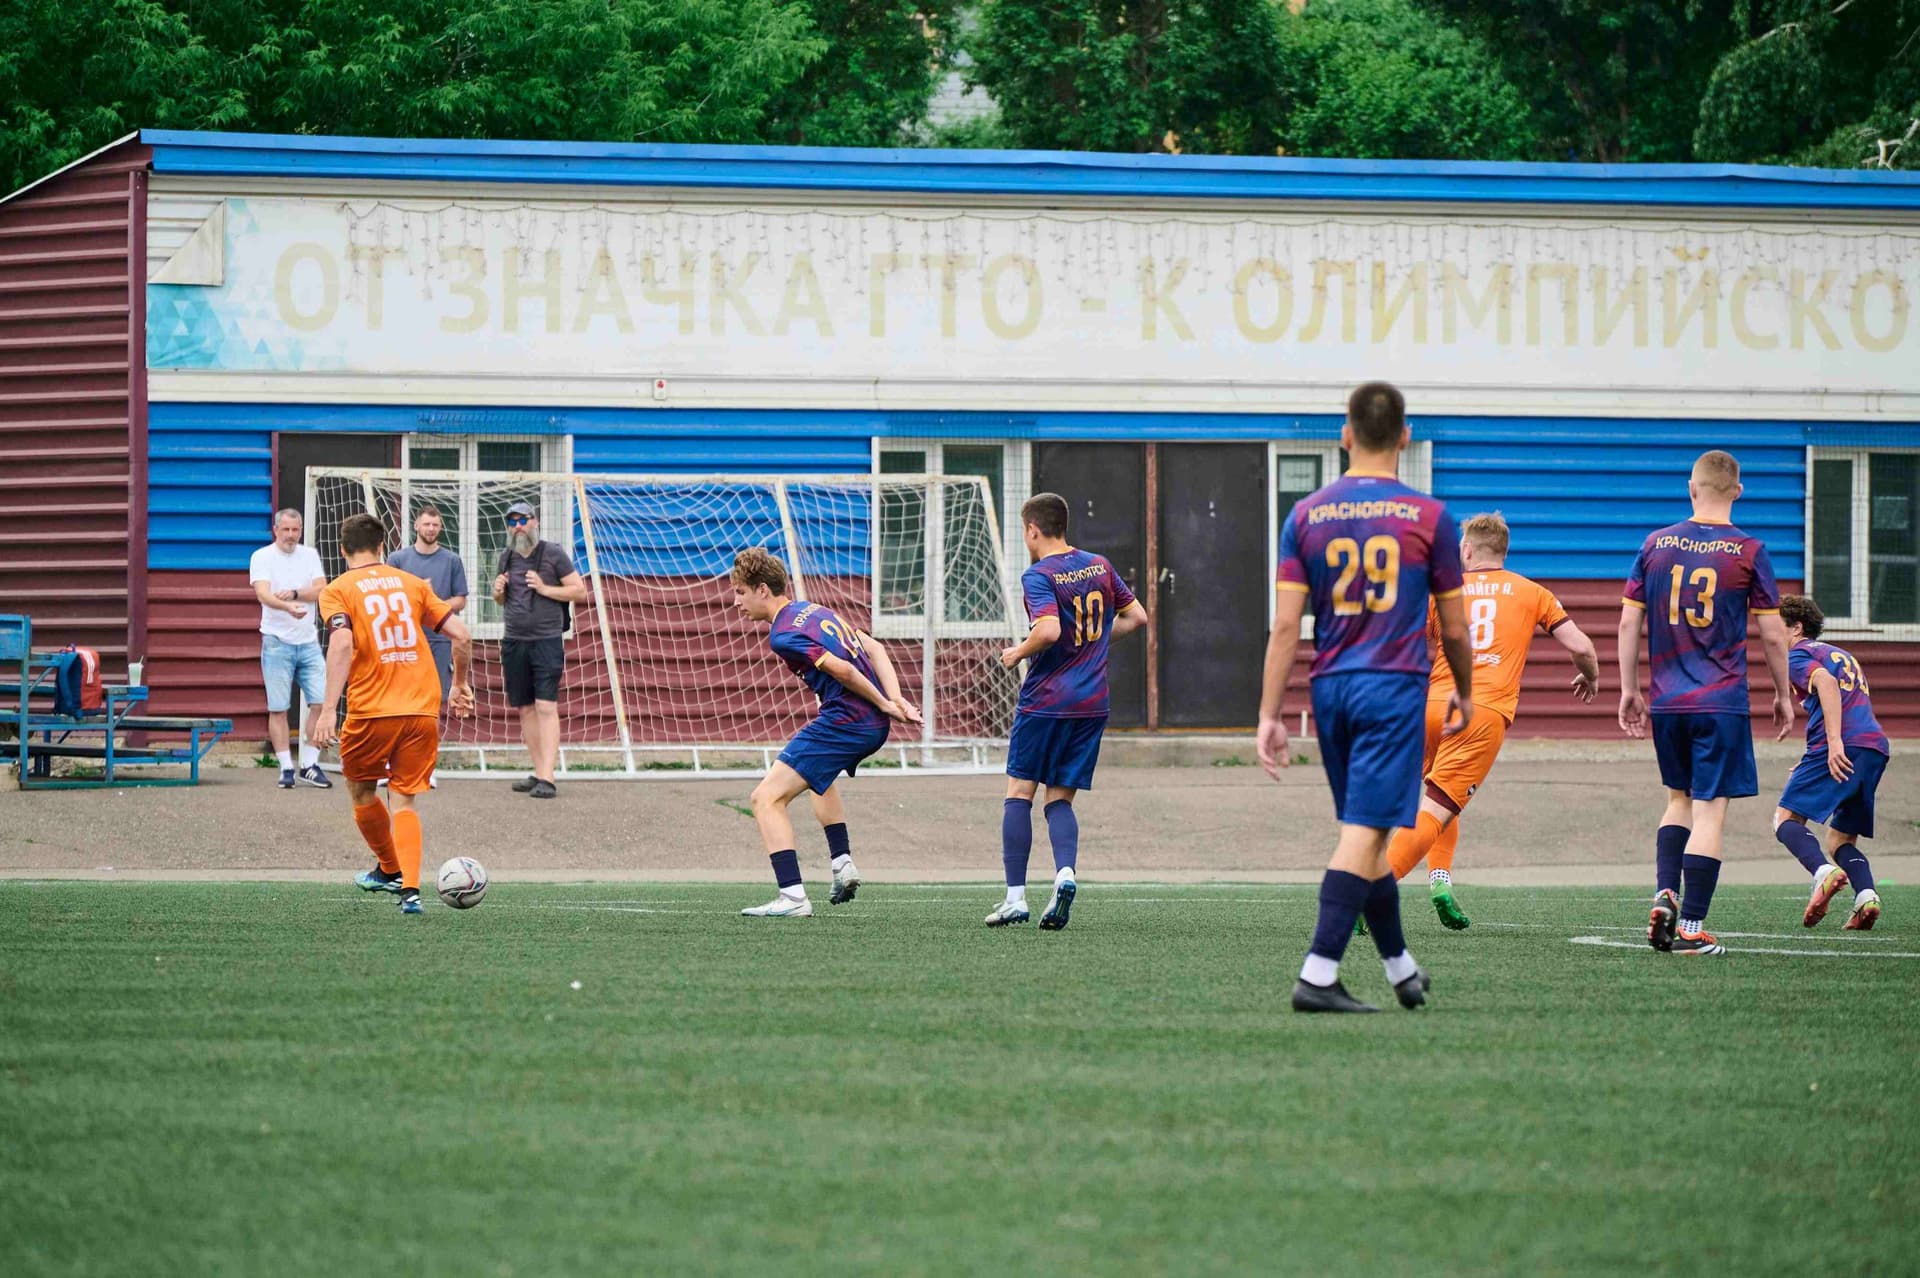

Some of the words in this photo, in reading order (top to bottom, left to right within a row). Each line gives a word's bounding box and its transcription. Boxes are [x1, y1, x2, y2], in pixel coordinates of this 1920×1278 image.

[274, 241, 402, 332] ОТ
[437, 245, 835, 338] ЗНАЧКА
[868, 251, 1043, 341] ГТО
[1141, 254, 1196, 341] К
[1308, 500, 1421, 525] КРАСНОЯРСК
[1655, 535, 1744, 556] КРАСНОЯРСК
[1325, 535, 1400, 616] 29
[1668, 563, 1718, 628] 13
[364, 591, 417, 651] 23
[820, 614, 865, 659] 24
[1073, 590, 1104, 647] 10
[1469, 598, 1497, 650] 8
